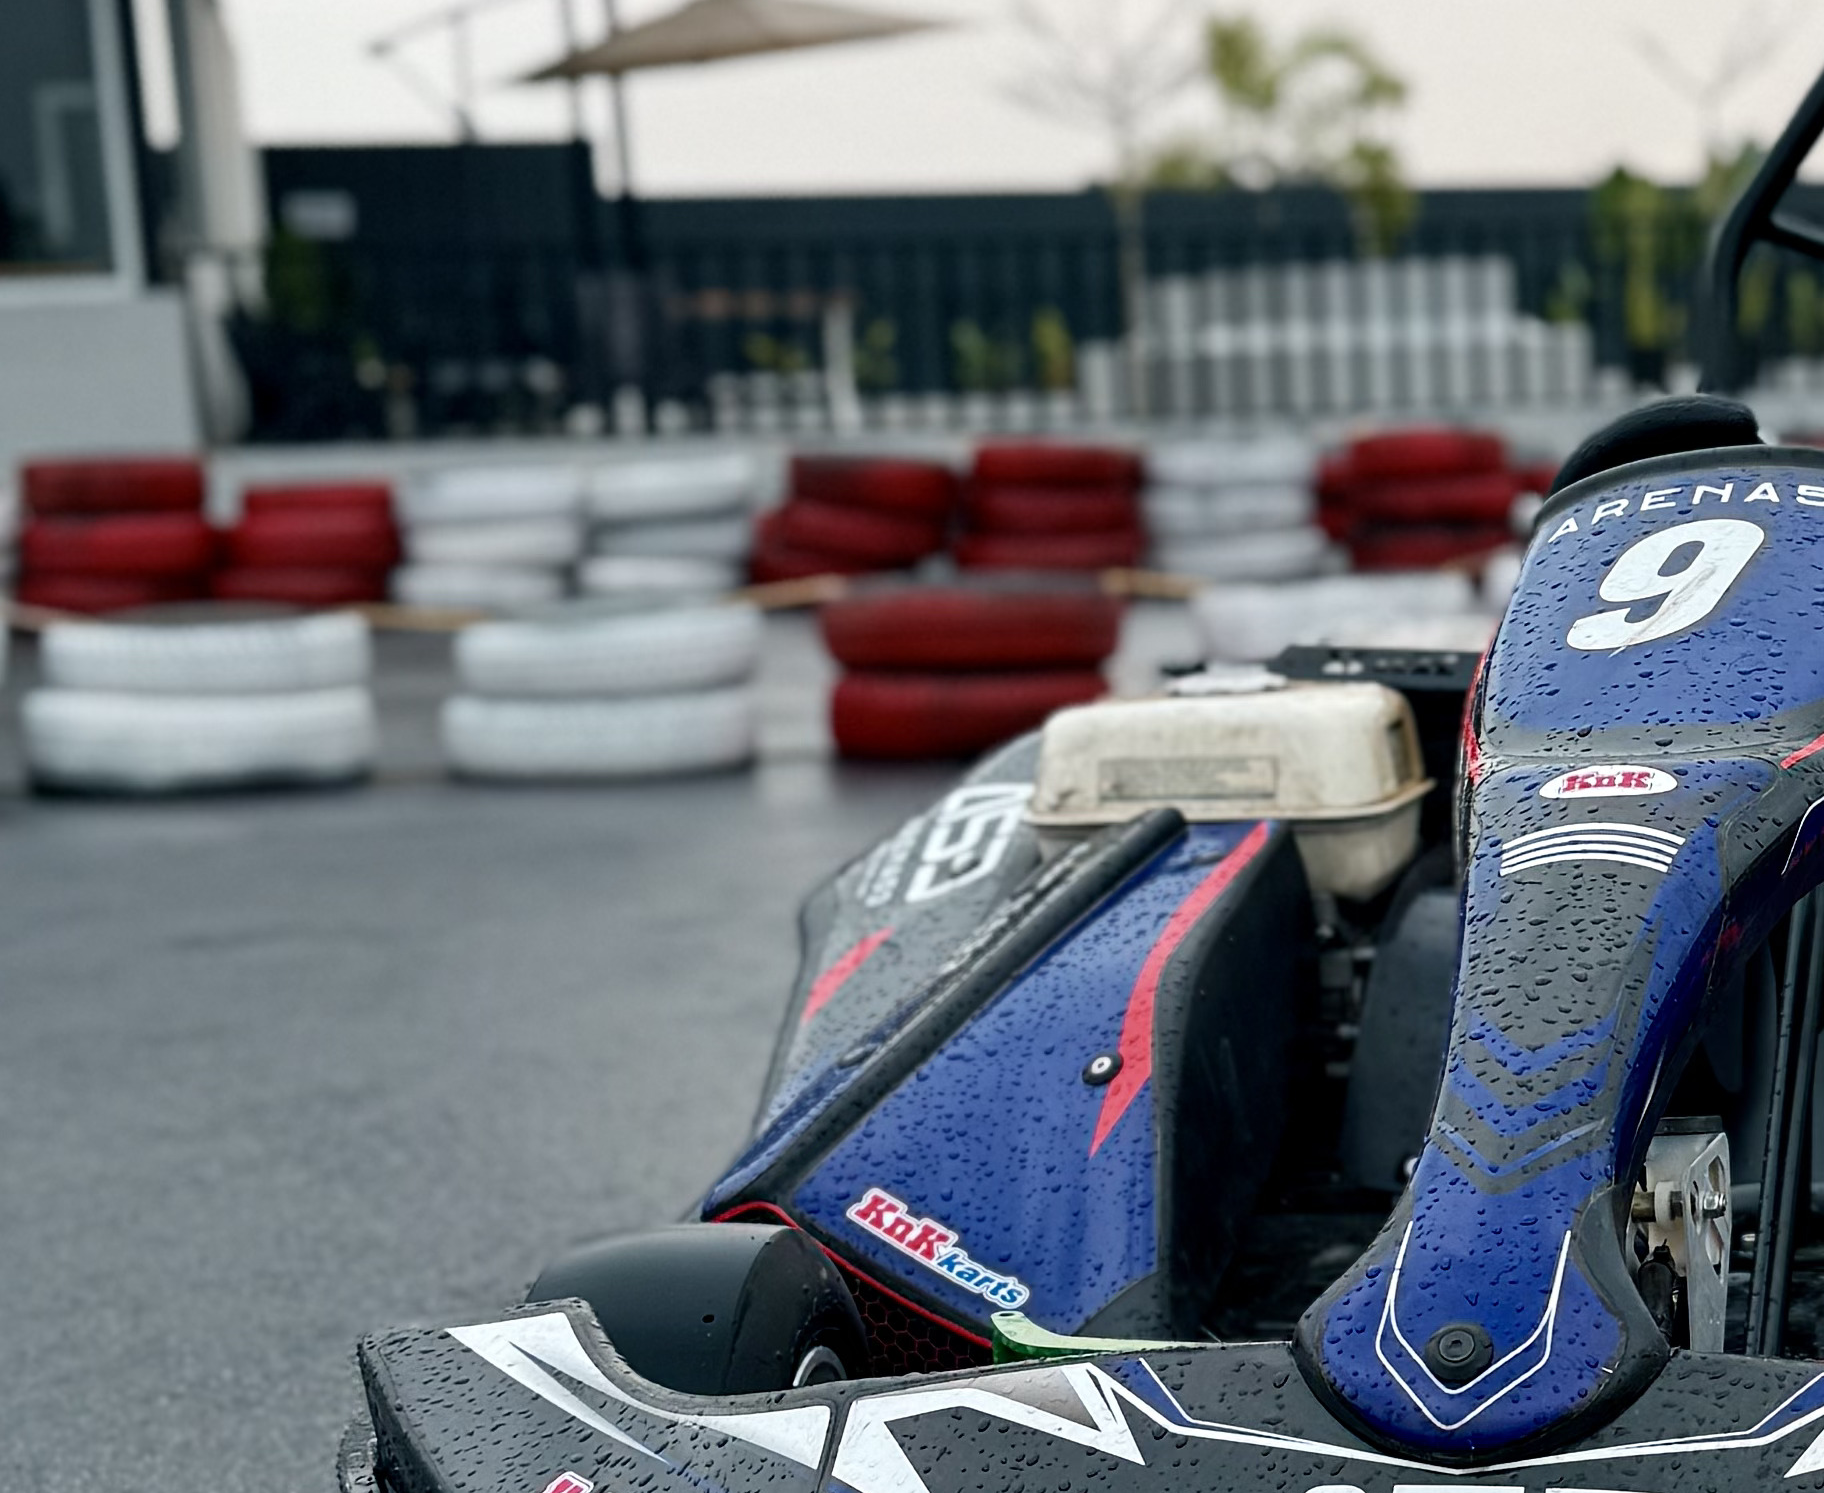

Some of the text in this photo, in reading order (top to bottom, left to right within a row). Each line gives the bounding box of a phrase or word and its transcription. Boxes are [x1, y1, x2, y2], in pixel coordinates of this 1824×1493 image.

[1566, 518, 1766, 651] 9
[1562, 771, 1652, 794] KnK
[854, 1193, 1023, 1304] KnK karts
